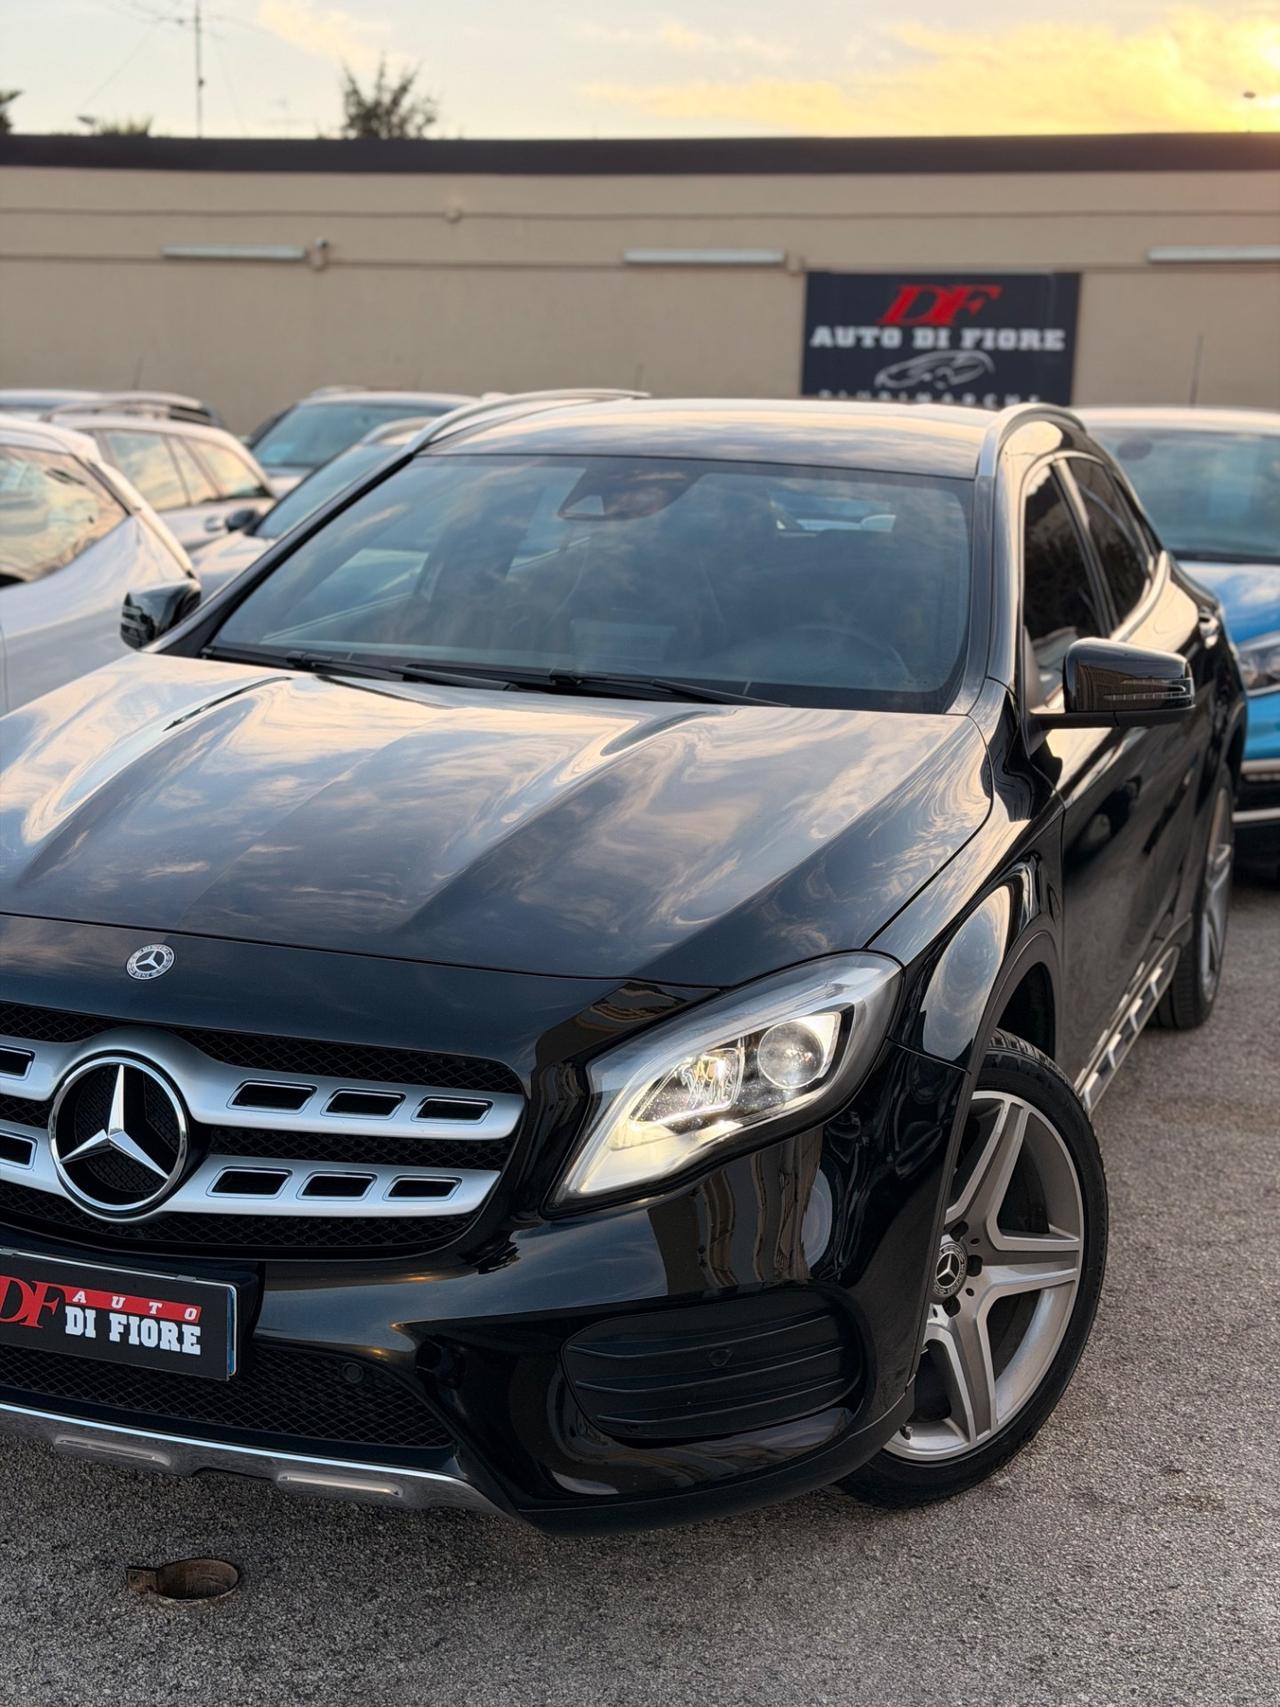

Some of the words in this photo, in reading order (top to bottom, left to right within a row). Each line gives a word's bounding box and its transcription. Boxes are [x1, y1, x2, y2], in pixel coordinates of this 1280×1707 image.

[878, 284, 1002, 326] DF
[810, 326, 902, 348] AUTO
[912, 328, 951, 348] DI
[960, 328, 1066, 350] FIORE
[0, 1275, 66, 1328] DF
[72, 1290, 198, 1321] AUTO
[65, 1305, 96, 1338] DI
[109, 1313, 201, 1356] FIORE
